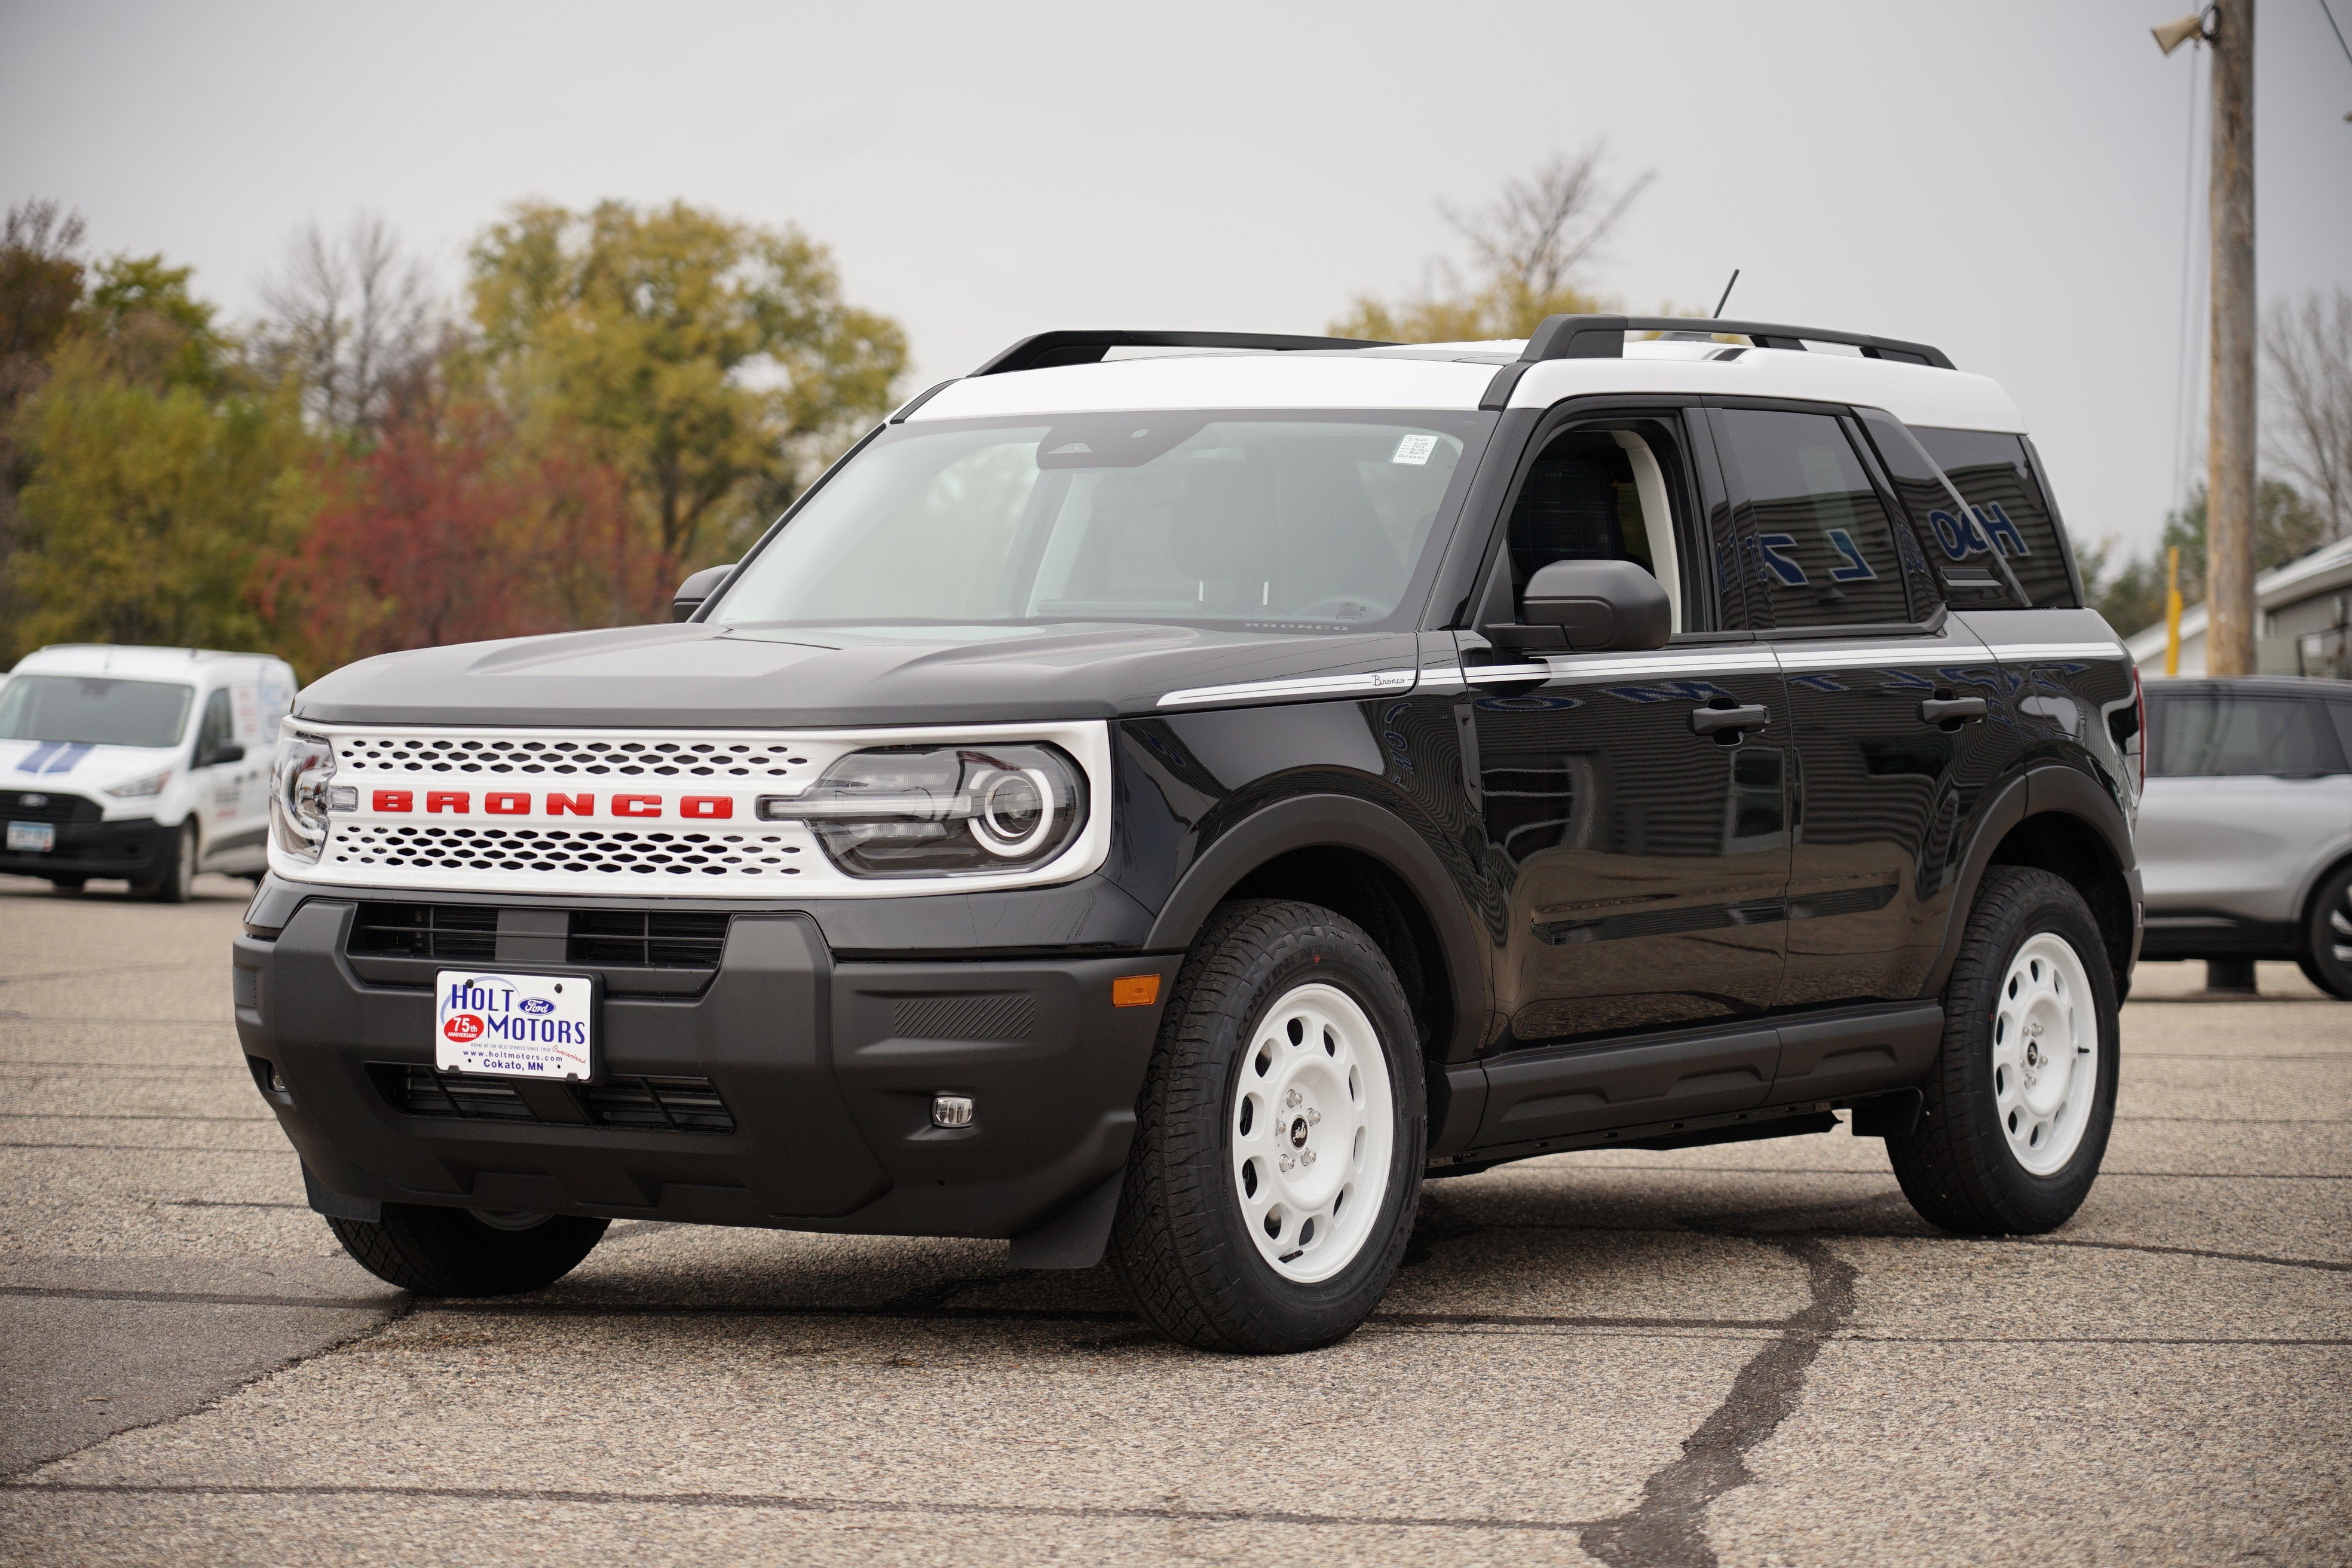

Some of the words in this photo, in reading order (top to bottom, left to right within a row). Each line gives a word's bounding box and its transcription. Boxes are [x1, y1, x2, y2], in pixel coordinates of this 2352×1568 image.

[1371, 675, 1405, 686] Bronco
[372, 789, 733, 819] BRONCO
[451, 984, 514, 1012] HOLT
[525, 999, 548, 1014] Ford
[453, 1017, 477, 1033] 75th
[488, 1013, 586, 1045] MOTORS
[463, 1050, 562, 1062] www.holtmotors.com
[552, 1045, 587, 1064] Guaranteed
[484, 1058, 525, 1072] Cokato,
[528, 1062, 544, 1071] MN
